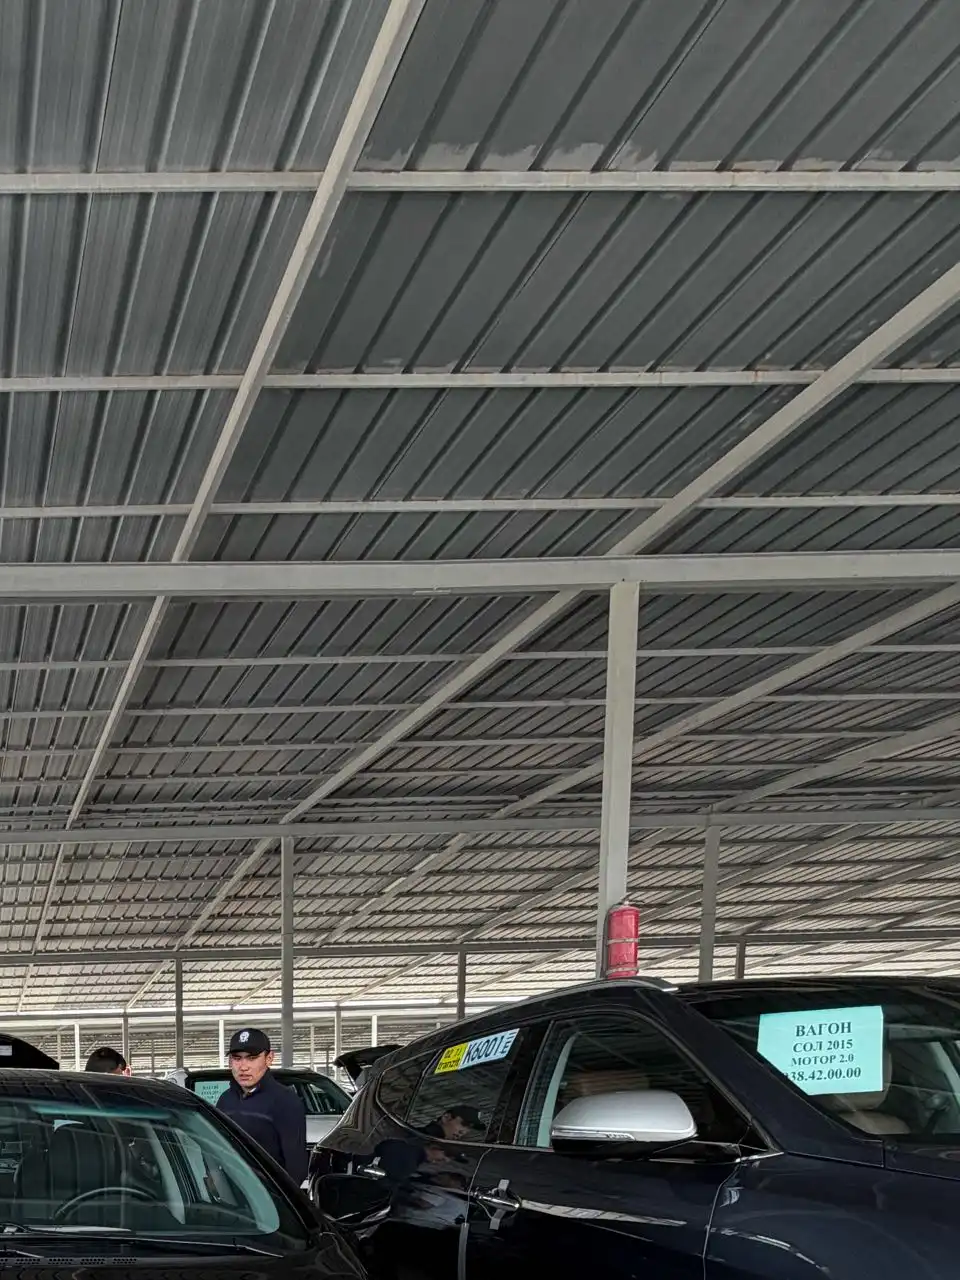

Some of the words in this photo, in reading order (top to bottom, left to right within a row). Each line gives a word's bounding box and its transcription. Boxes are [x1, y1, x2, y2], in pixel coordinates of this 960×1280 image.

[795, 1022, 852, 1037] ВАГОН
[793, 1041, 823, 1053] СОЛ
[827, 1039, 853, 1051] 2015
[791, 1055, 837, 1067] МОТОР
[839, 1053, 855, 1063] 2.0
[786, 1067, 862, 1082] 38.42.00.00
